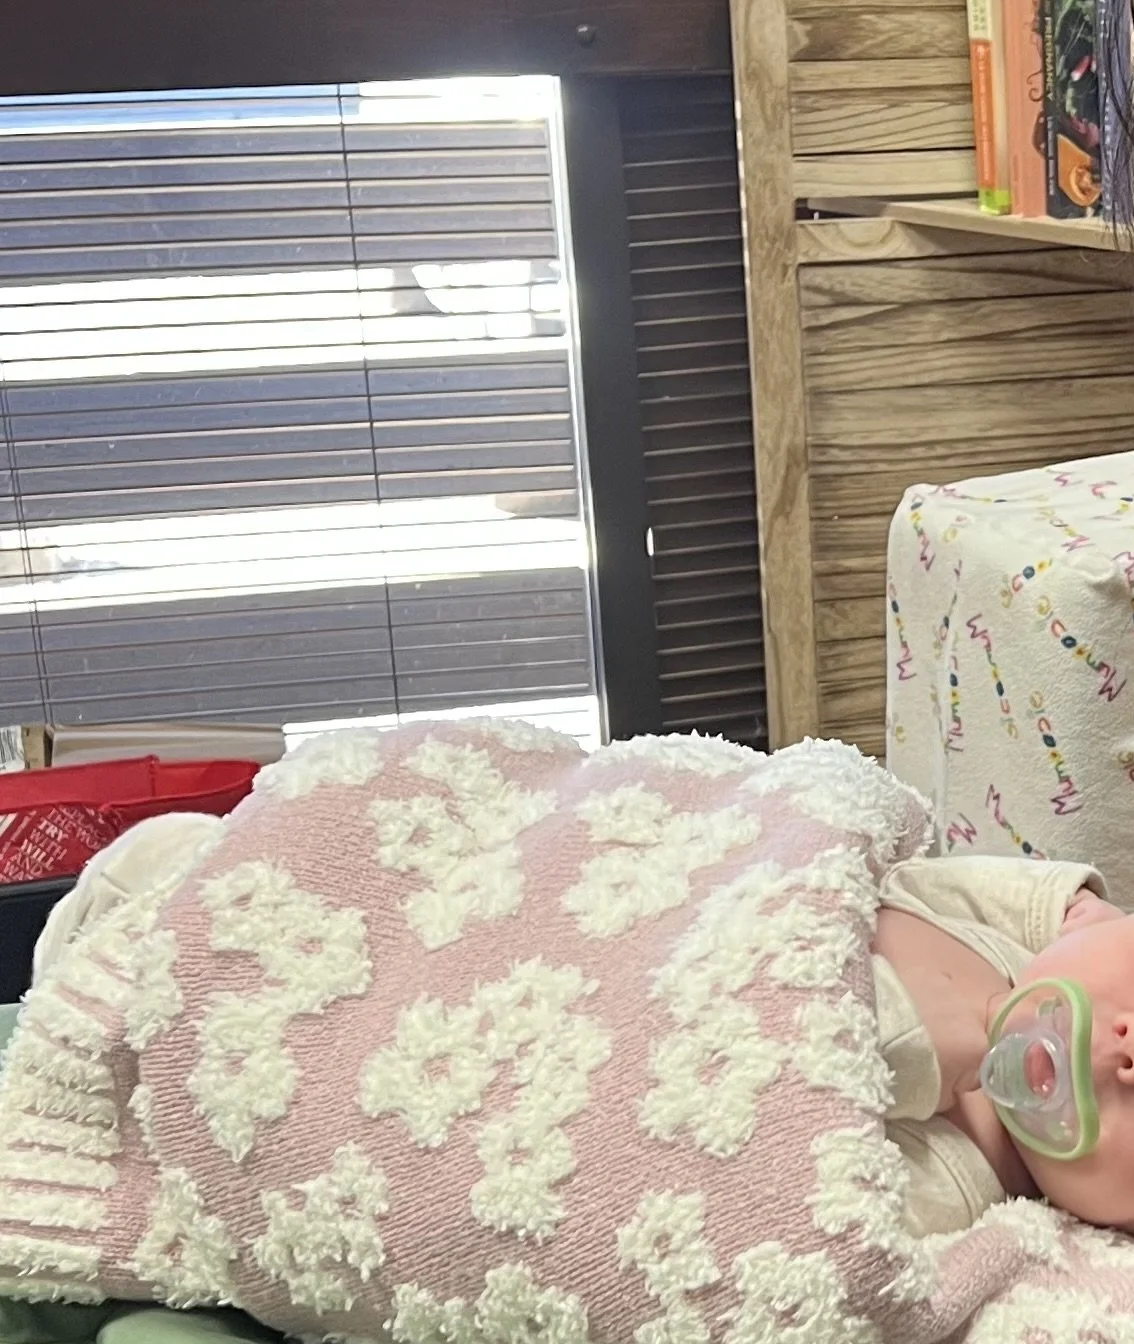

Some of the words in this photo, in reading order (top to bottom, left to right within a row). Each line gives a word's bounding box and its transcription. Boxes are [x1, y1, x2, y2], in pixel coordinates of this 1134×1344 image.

[30, 828, 68, 861] WITH
[38, 819, 69, 842] TRY
[9, 853, 43, 876] AND
[21, 838, 54, 872] WILL
